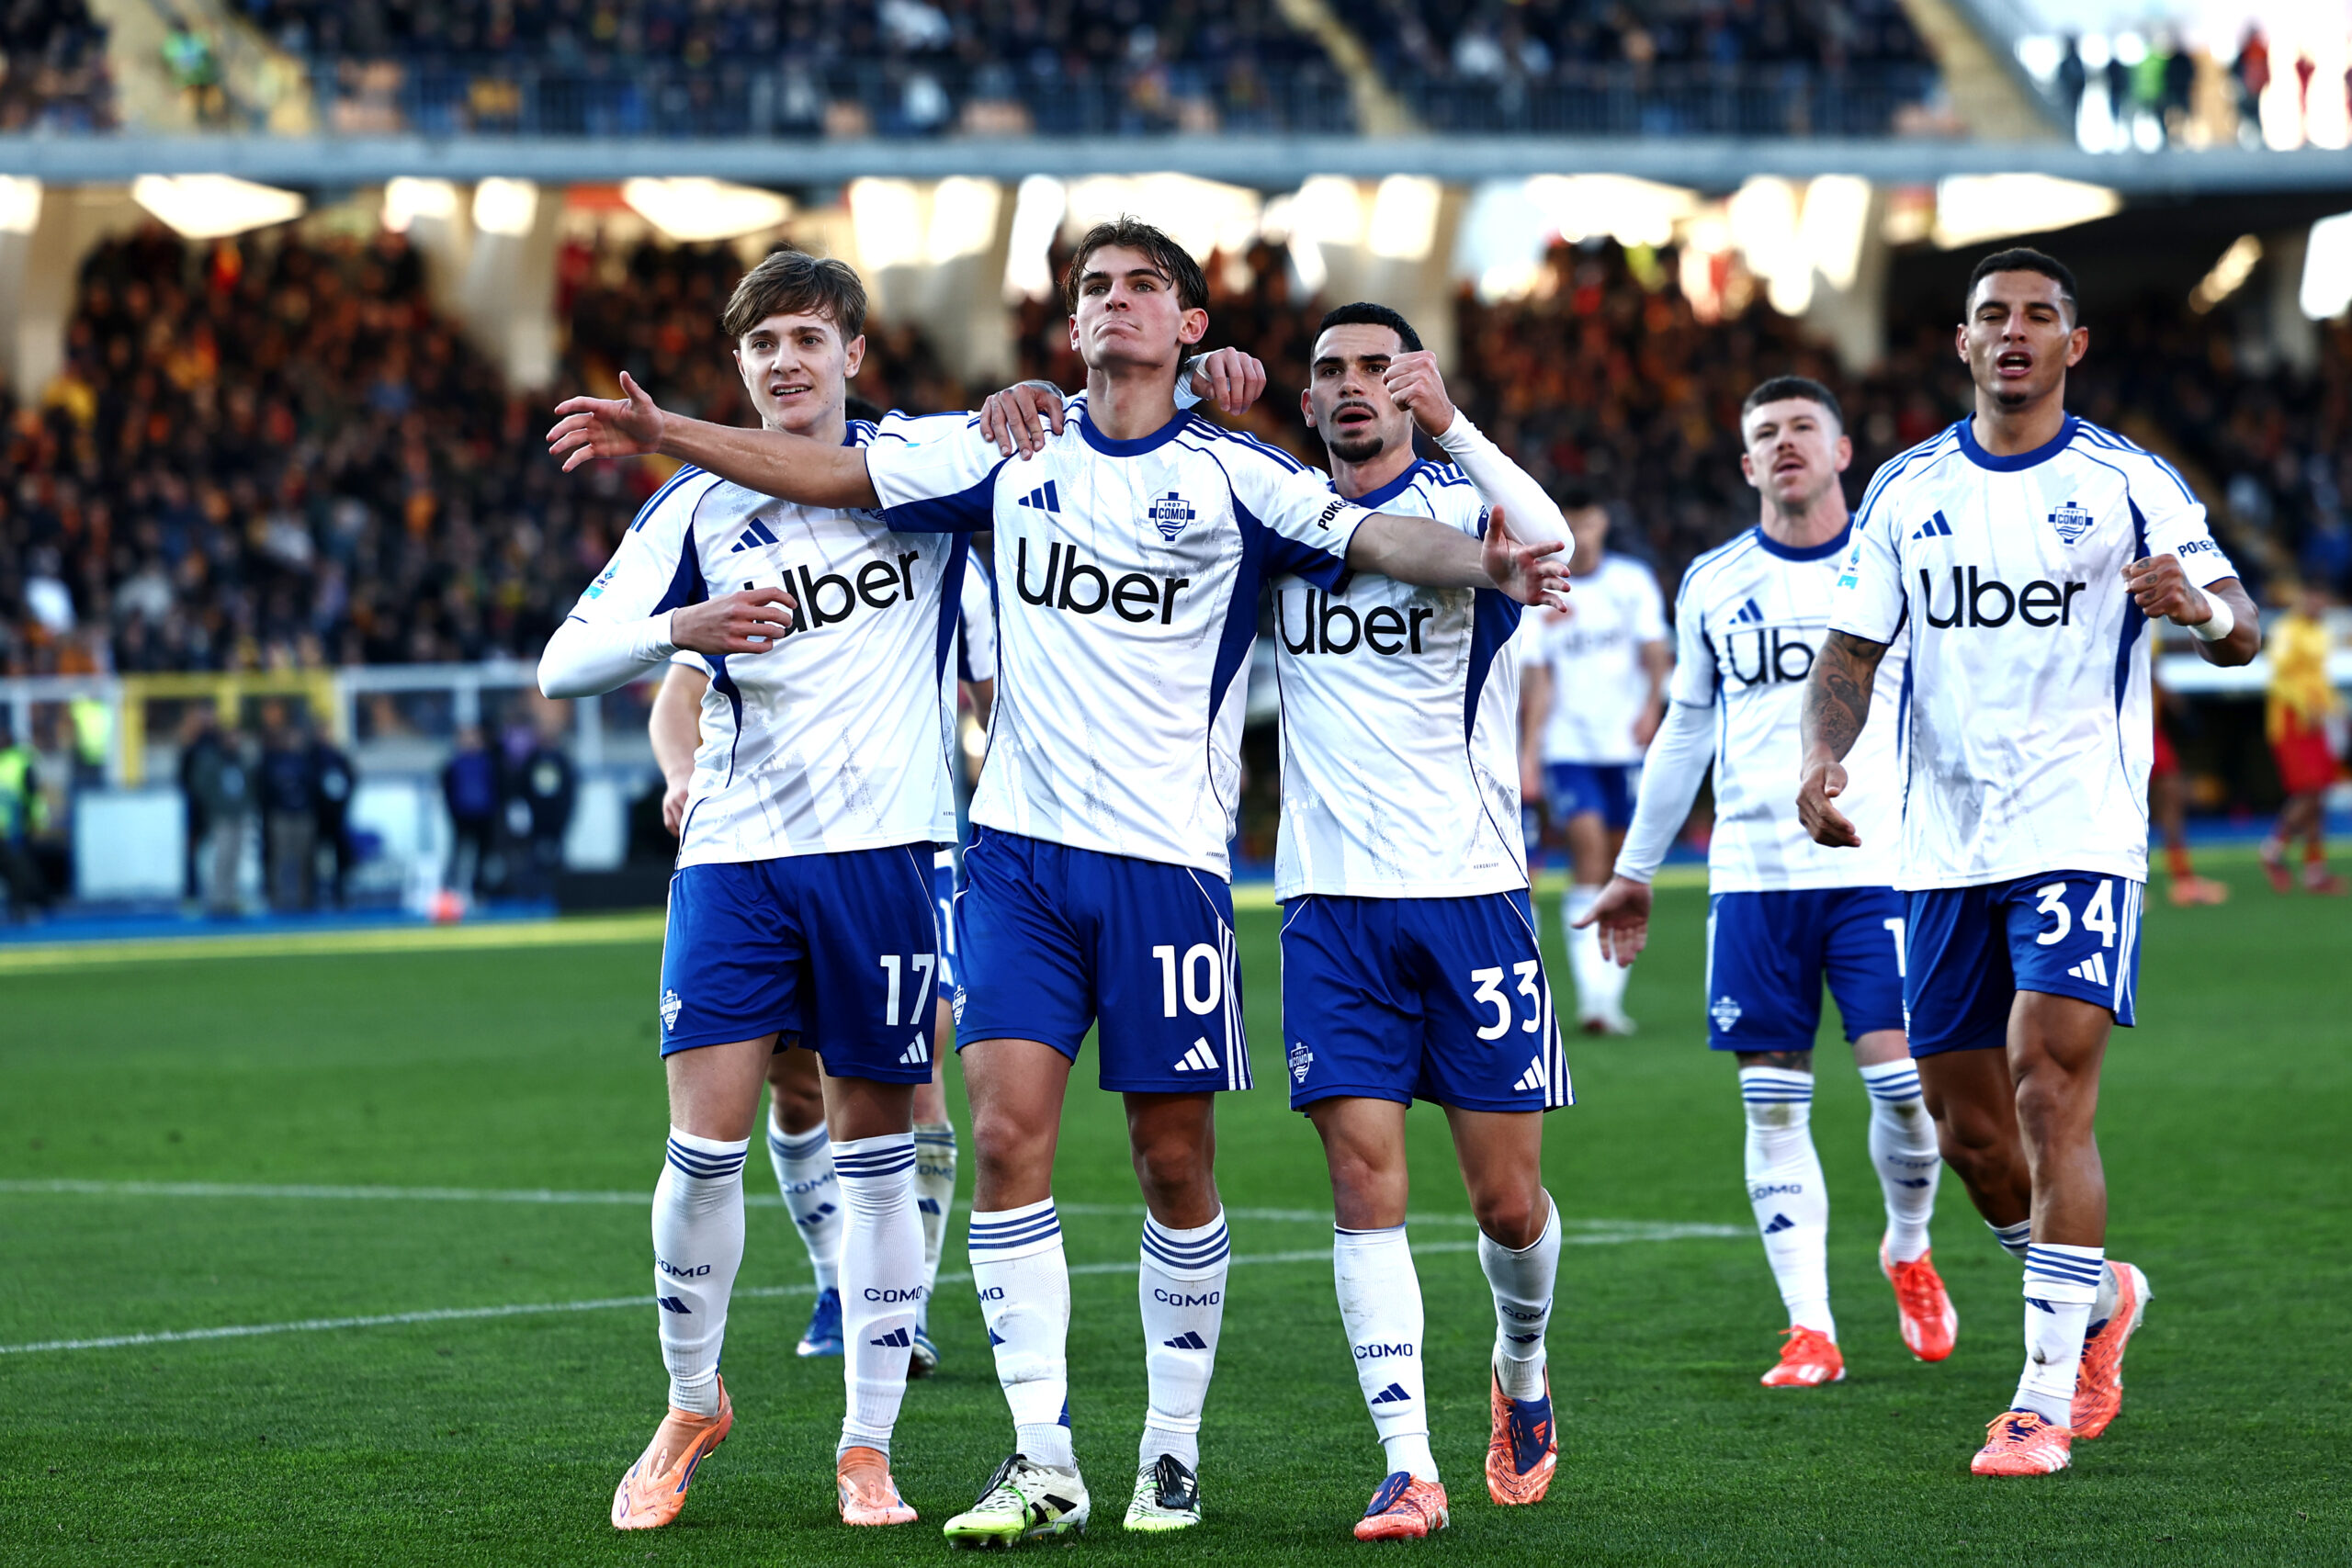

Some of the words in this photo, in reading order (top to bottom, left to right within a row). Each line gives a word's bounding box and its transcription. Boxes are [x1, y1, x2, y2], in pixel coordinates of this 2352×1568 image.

[1159, 507, 1185, 520] COMO
[2058, 513, 2084, 525] COMO
[1016, 536, 1190, 625] Uber
[1919, 565, 2086, 628] Uber
[1277, 588, 1434, 656] Uber
[1725, 626, 1815, 686] Ub
[2035, 879, 2117, 948] 34
[879, 953, 935, 1026] 17
[1152, 942, 1221, 1018] 10
[1471, 959, 1542, 1041] 33
[864, 1285, 922, 1303] COMO
[1154, 1288, 1220, 1307] COMO
[1354, 1343, 1413, 1359] COMO
